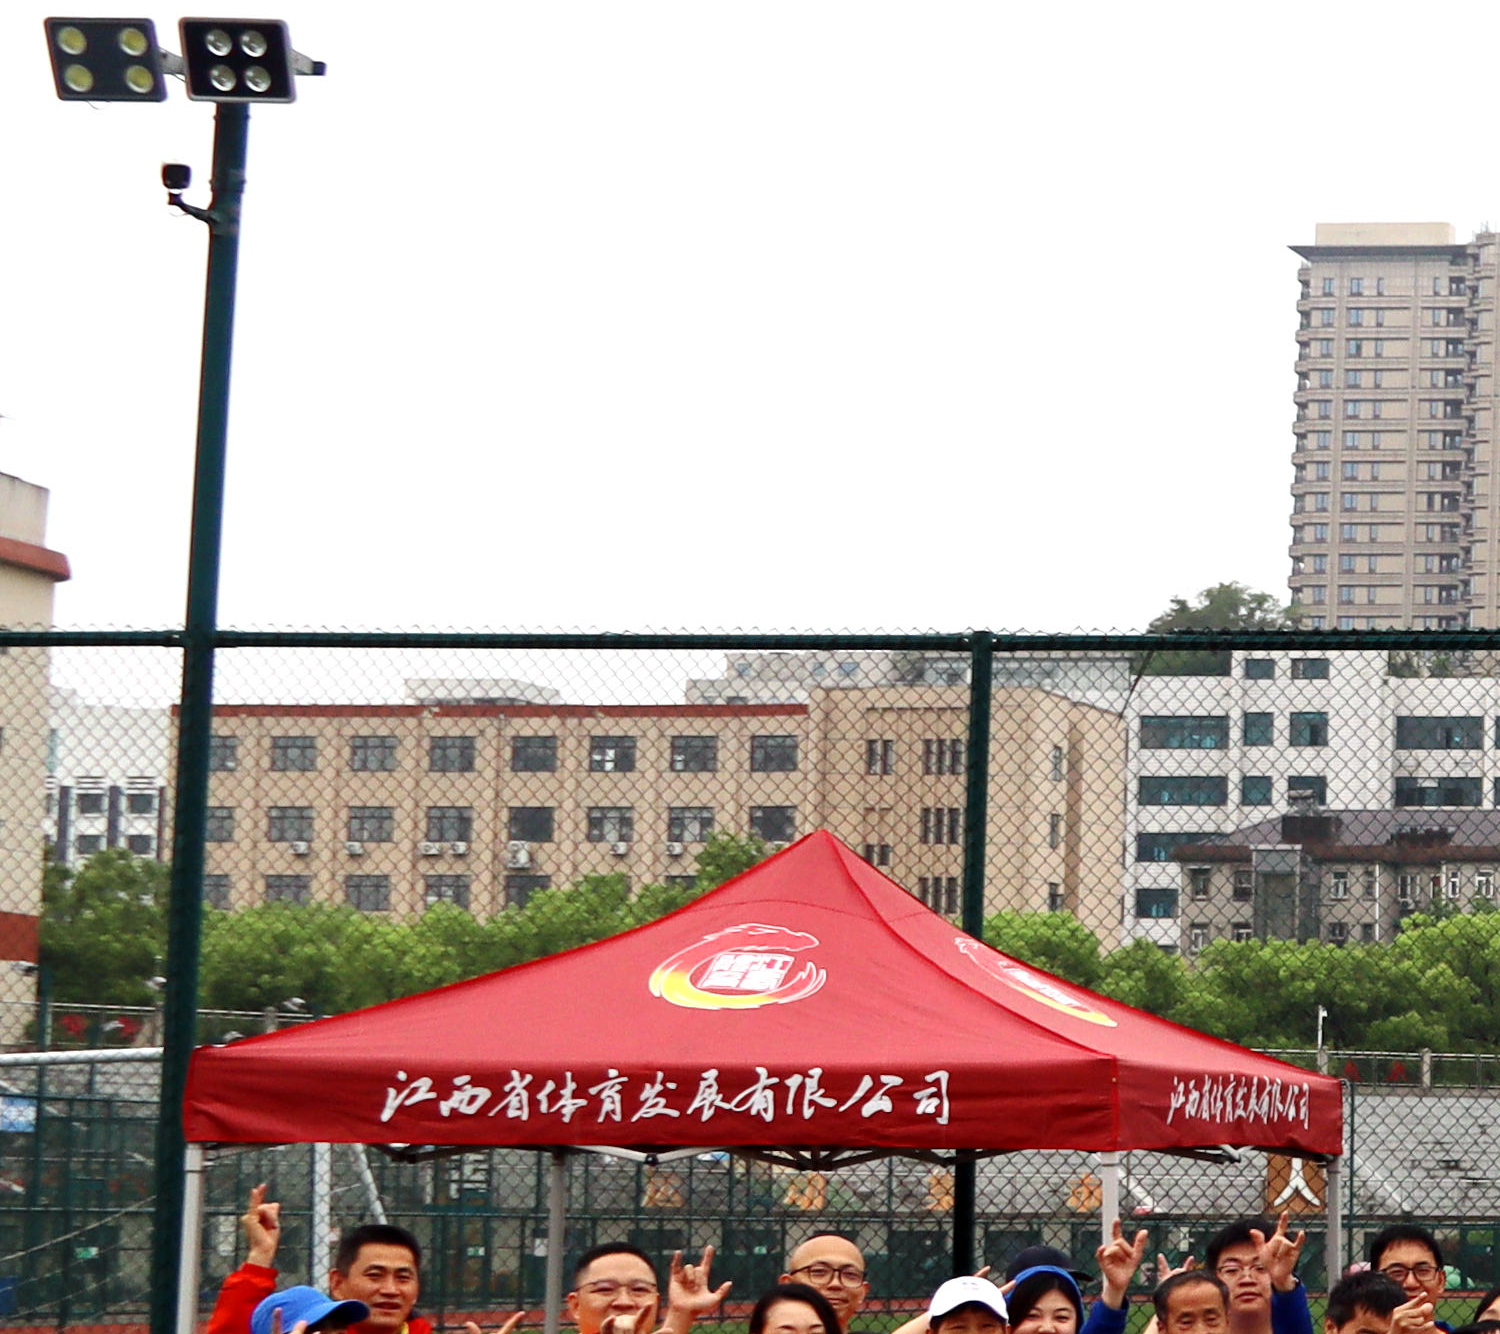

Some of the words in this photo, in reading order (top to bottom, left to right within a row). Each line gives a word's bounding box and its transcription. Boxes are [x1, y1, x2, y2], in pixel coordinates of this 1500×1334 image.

[380, 1067, 951, 1125] 江西省体育发展有限公司
[1167, 1075, 1312, 1129] 江西省体育发展有限公司
